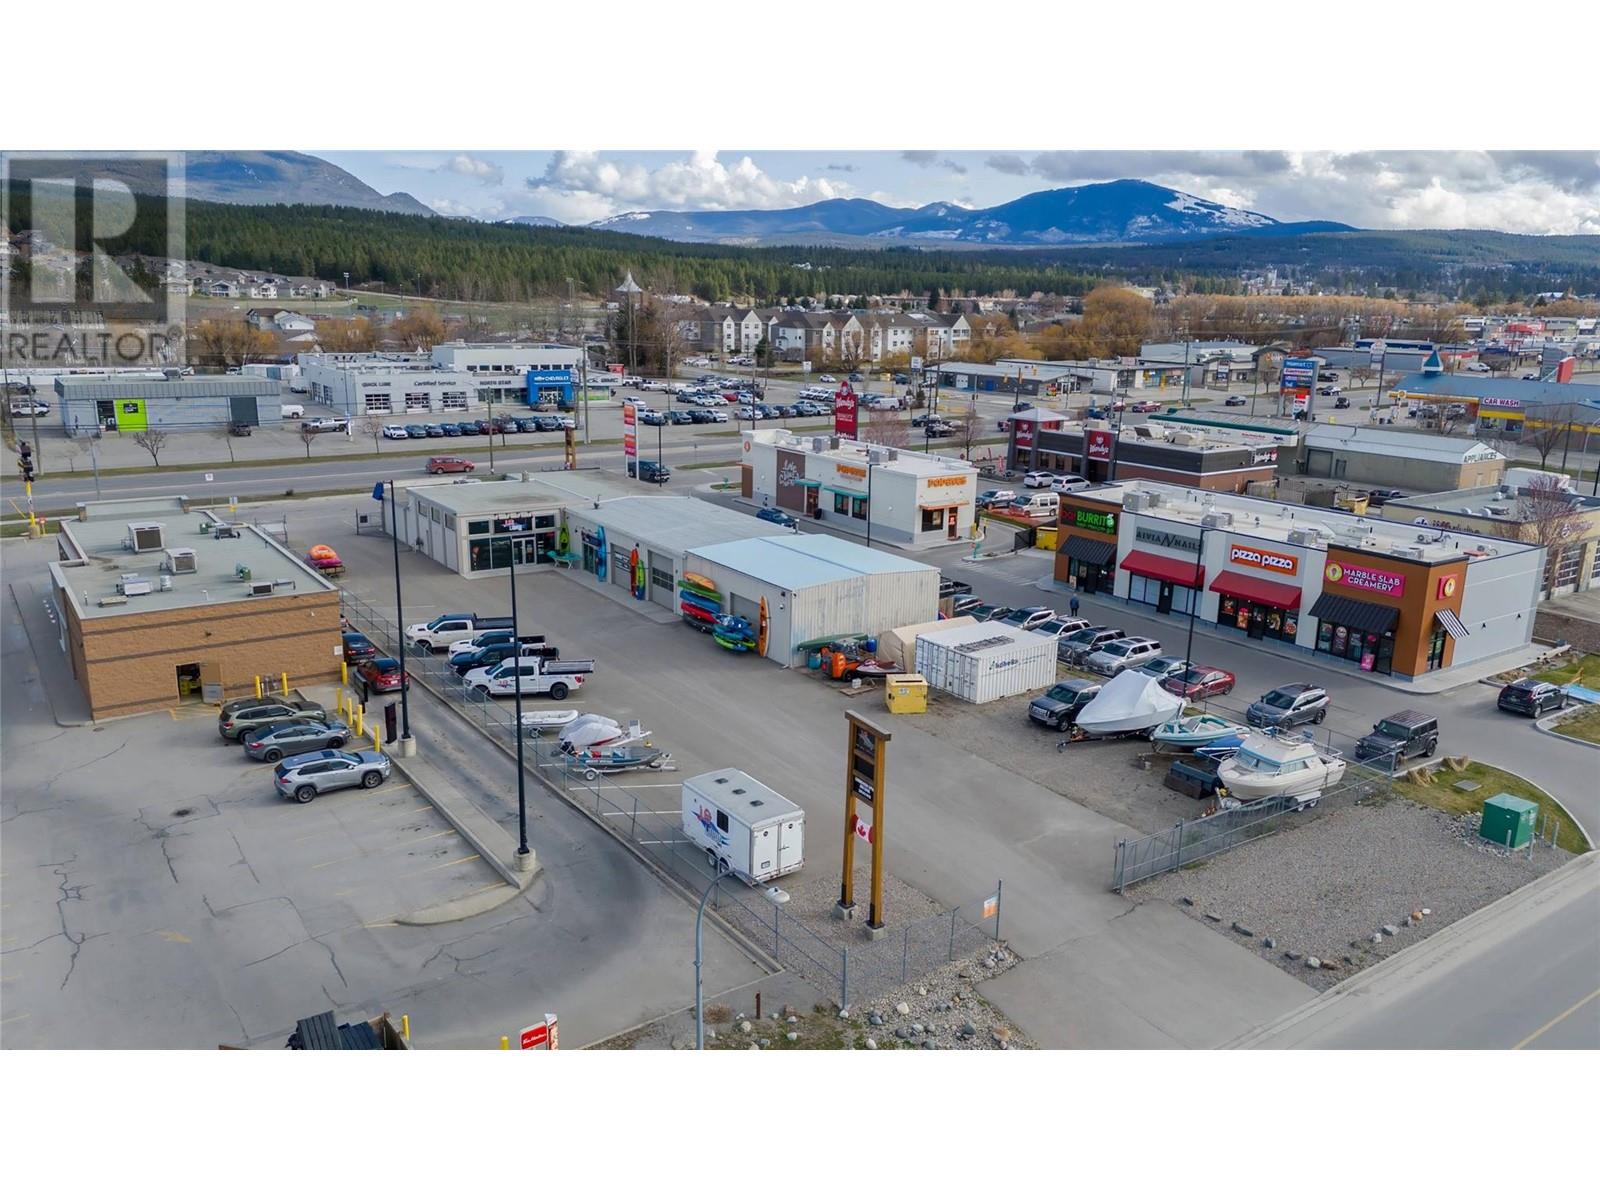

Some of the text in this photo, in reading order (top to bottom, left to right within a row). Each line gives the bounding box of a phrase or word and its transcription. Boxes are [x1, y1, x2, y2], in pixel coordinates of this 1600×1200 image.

[1484, 397, 1519, 407] CAR WASH
[1231, 548, 1293, 570] pizza pizza
[1343, 568, 1401, 586] MARBLE SLAB
[1347, 576, 1394, 592] CREAMERY
